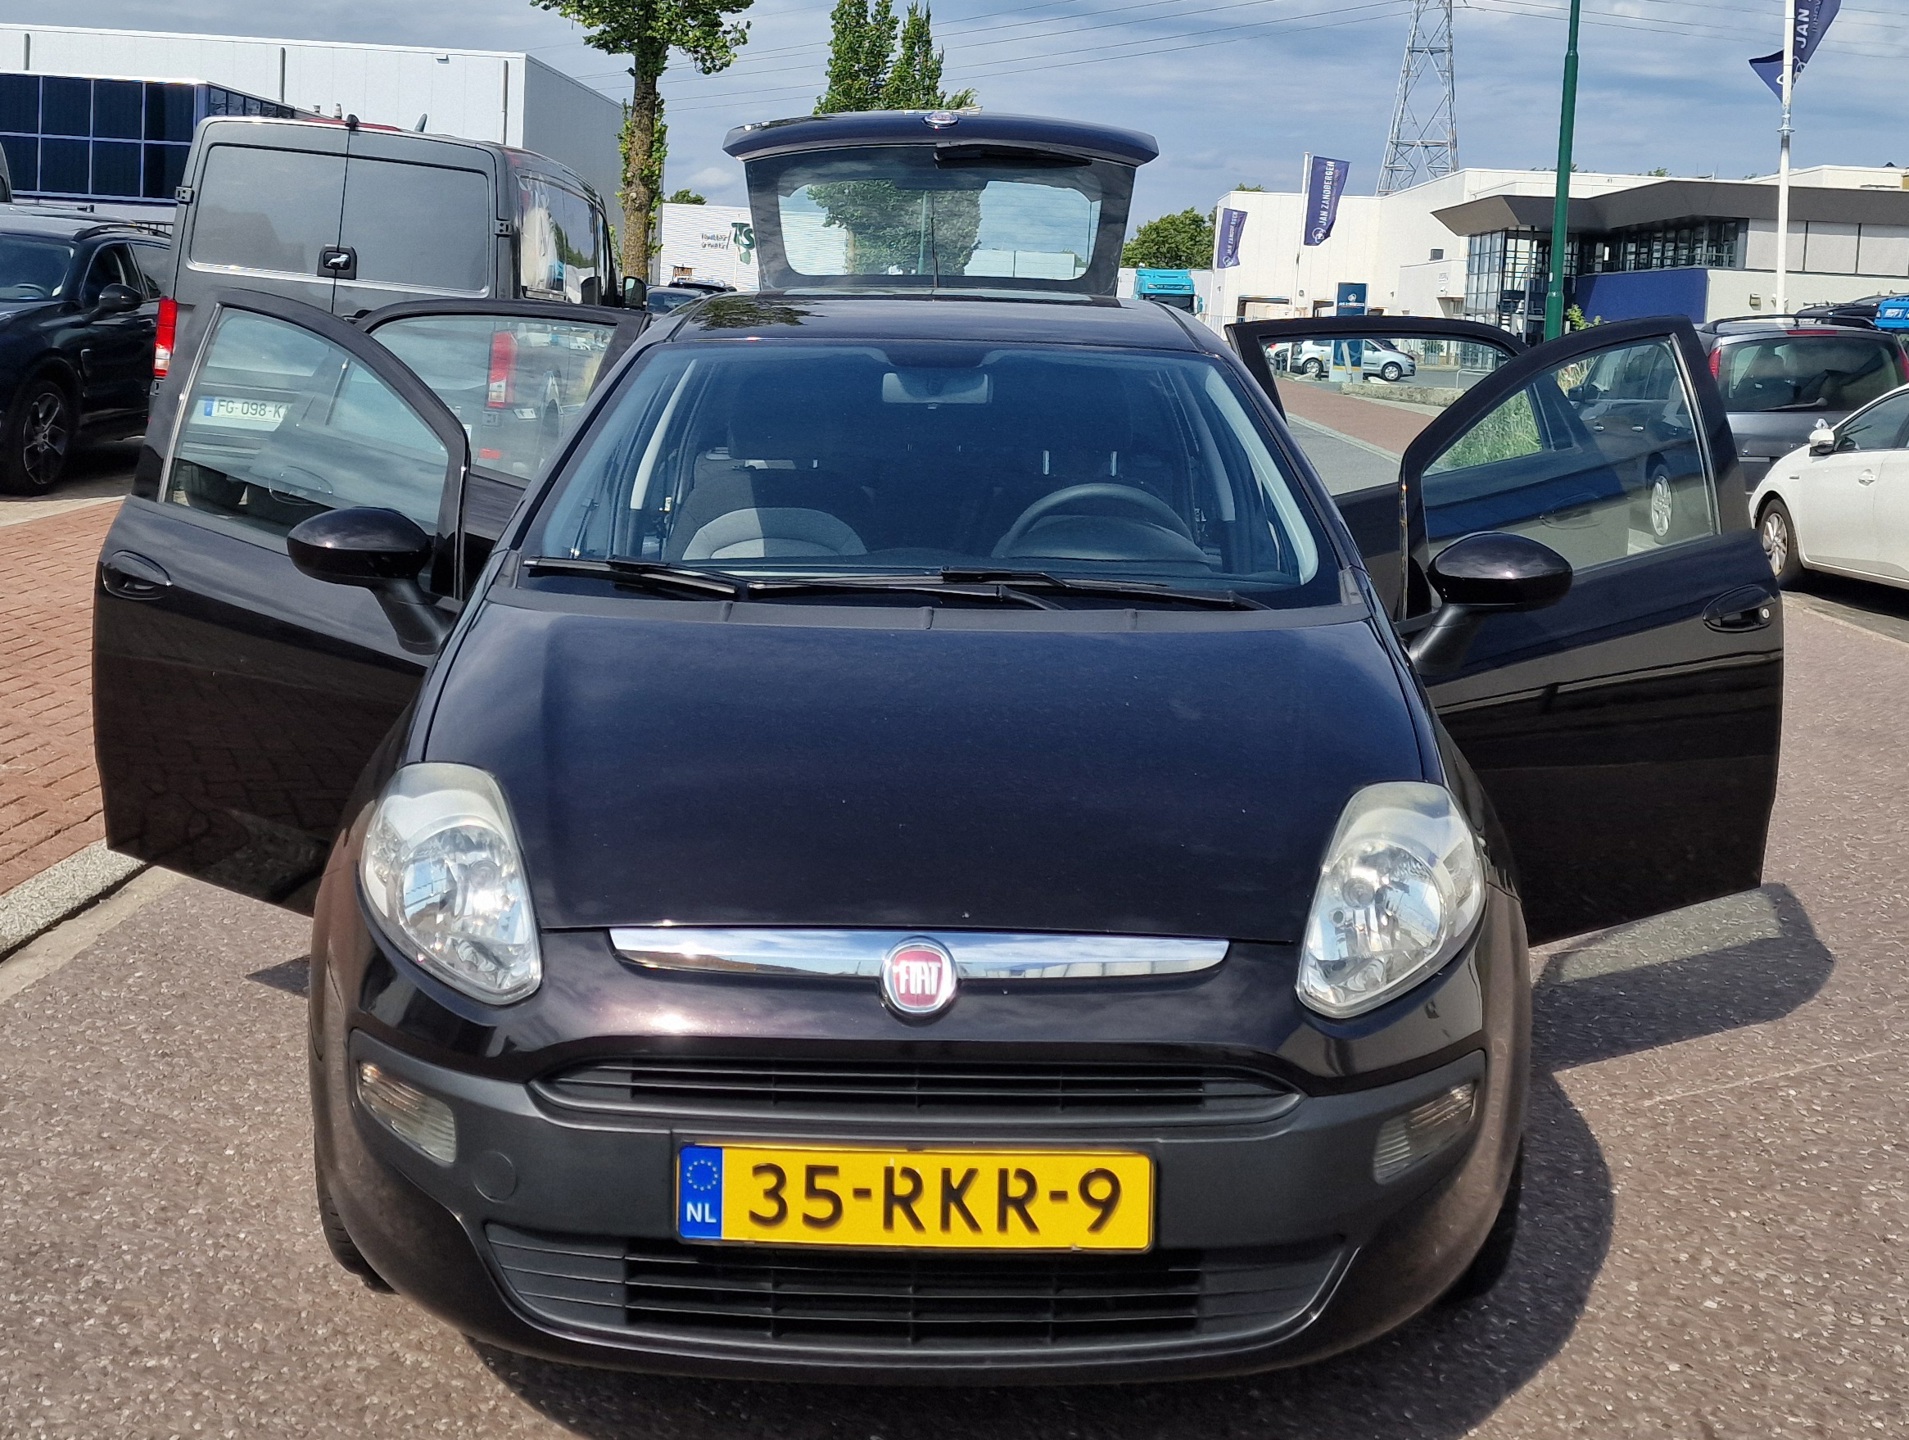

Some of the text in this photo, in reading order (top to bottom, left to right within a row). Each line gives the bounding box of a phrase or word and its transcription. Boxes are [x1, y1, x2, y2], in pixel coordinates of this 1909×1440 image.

[1796, 9, 1810, 48] JAN
[897, 960, 942, 995] FIAT
[686, 1203, 717, 1224] NL
[748, 1162, 1122, 1234] 35-RKR-9
